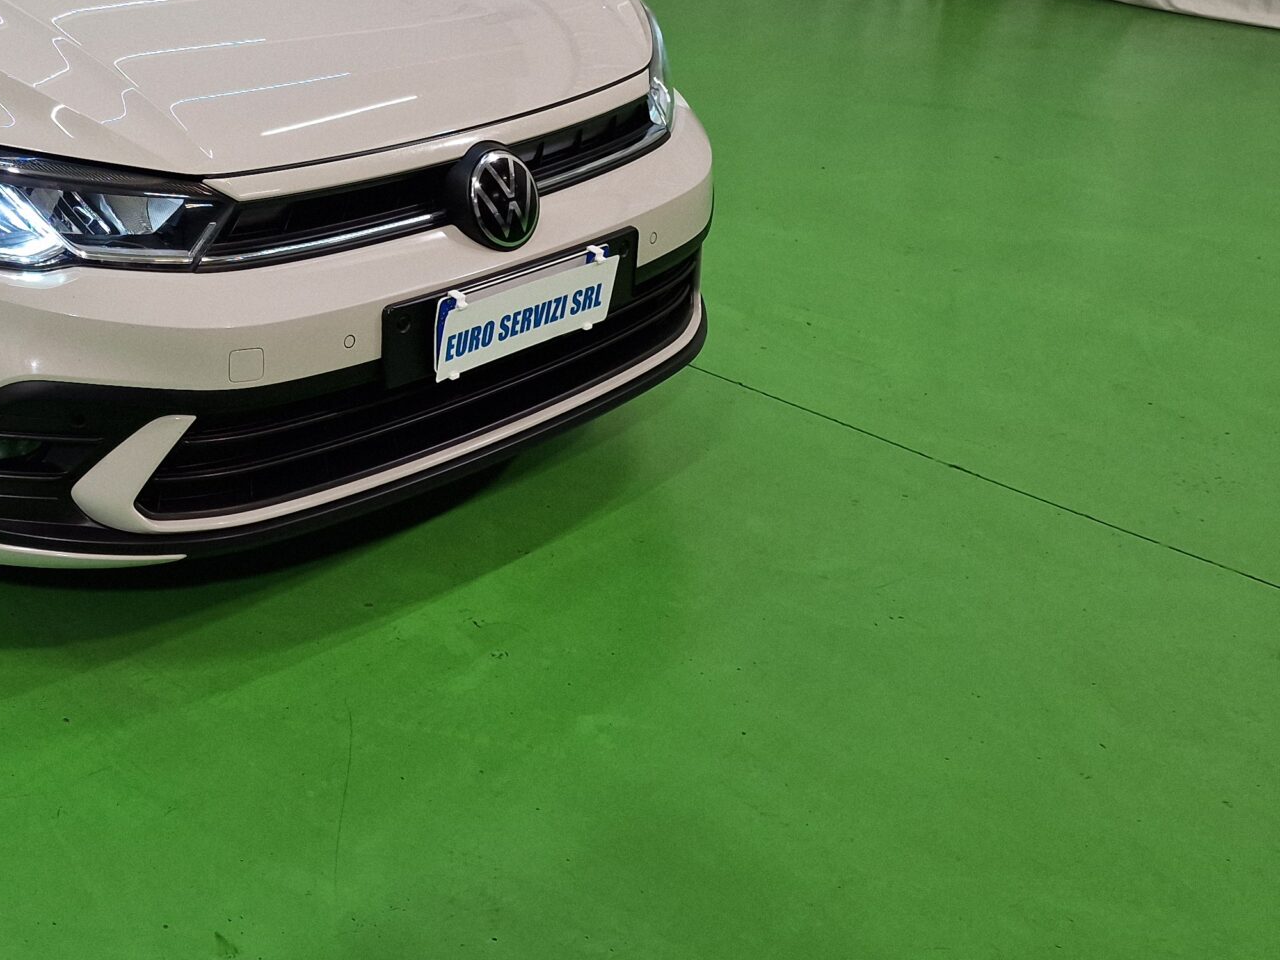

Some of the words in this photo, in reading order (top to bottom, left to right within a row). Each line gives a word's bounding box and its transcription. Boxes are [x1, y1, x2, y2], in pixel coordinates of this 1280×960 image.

[445, 321, 495, 362] EURO
[498, 294, 568, 342] SERVIZI
[570, 283, 603, 315] SRL
